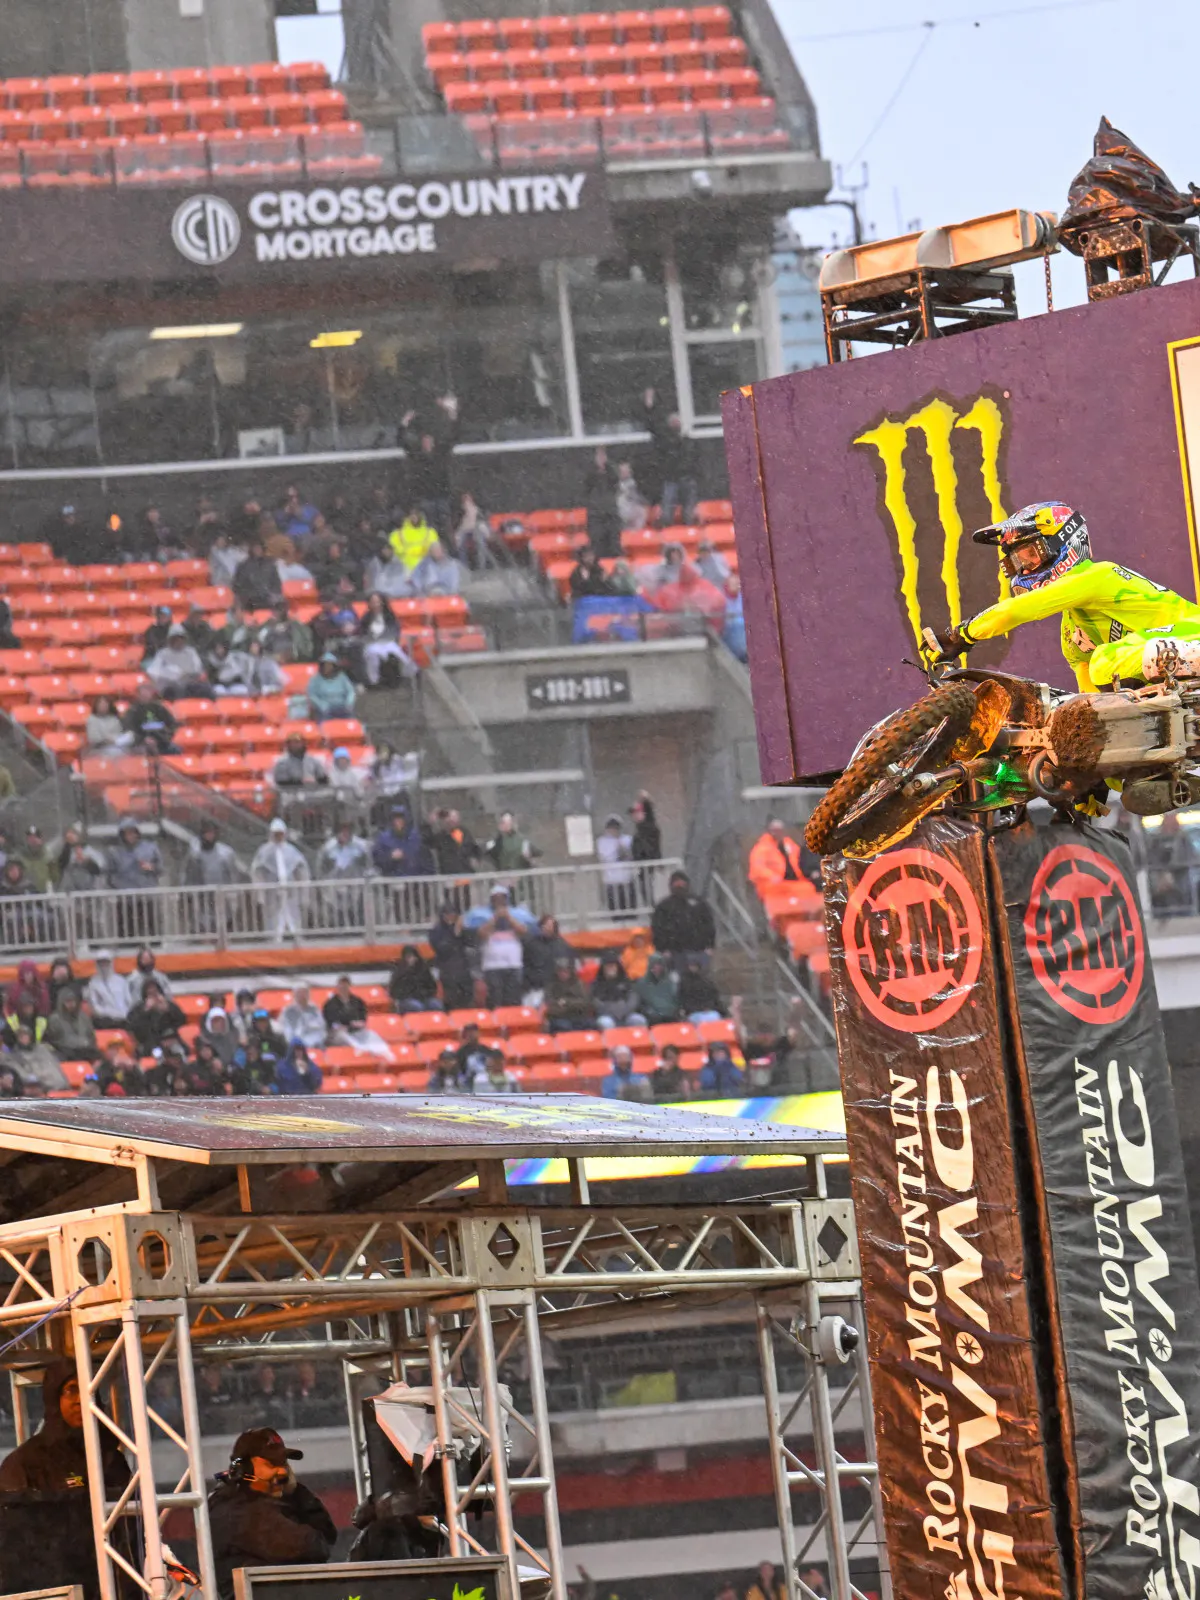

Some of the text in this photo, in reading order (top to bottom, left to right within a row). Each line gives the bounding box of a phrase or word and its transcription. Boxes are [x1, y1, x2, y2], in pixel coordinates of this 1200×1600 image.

[249, 173, 586, 229] CROSSCOUNTRY
[255, 223, 437, 262] MORTGAGE
[1057, 518, 1079, 542] FOX
[1056, 548, 1079, 575] Bull
[889, 1069, 963, 1560] ROCKY MOUNTAIN
[1074, 1058, 1161, 1558] ROCKY MOUNTAIN
